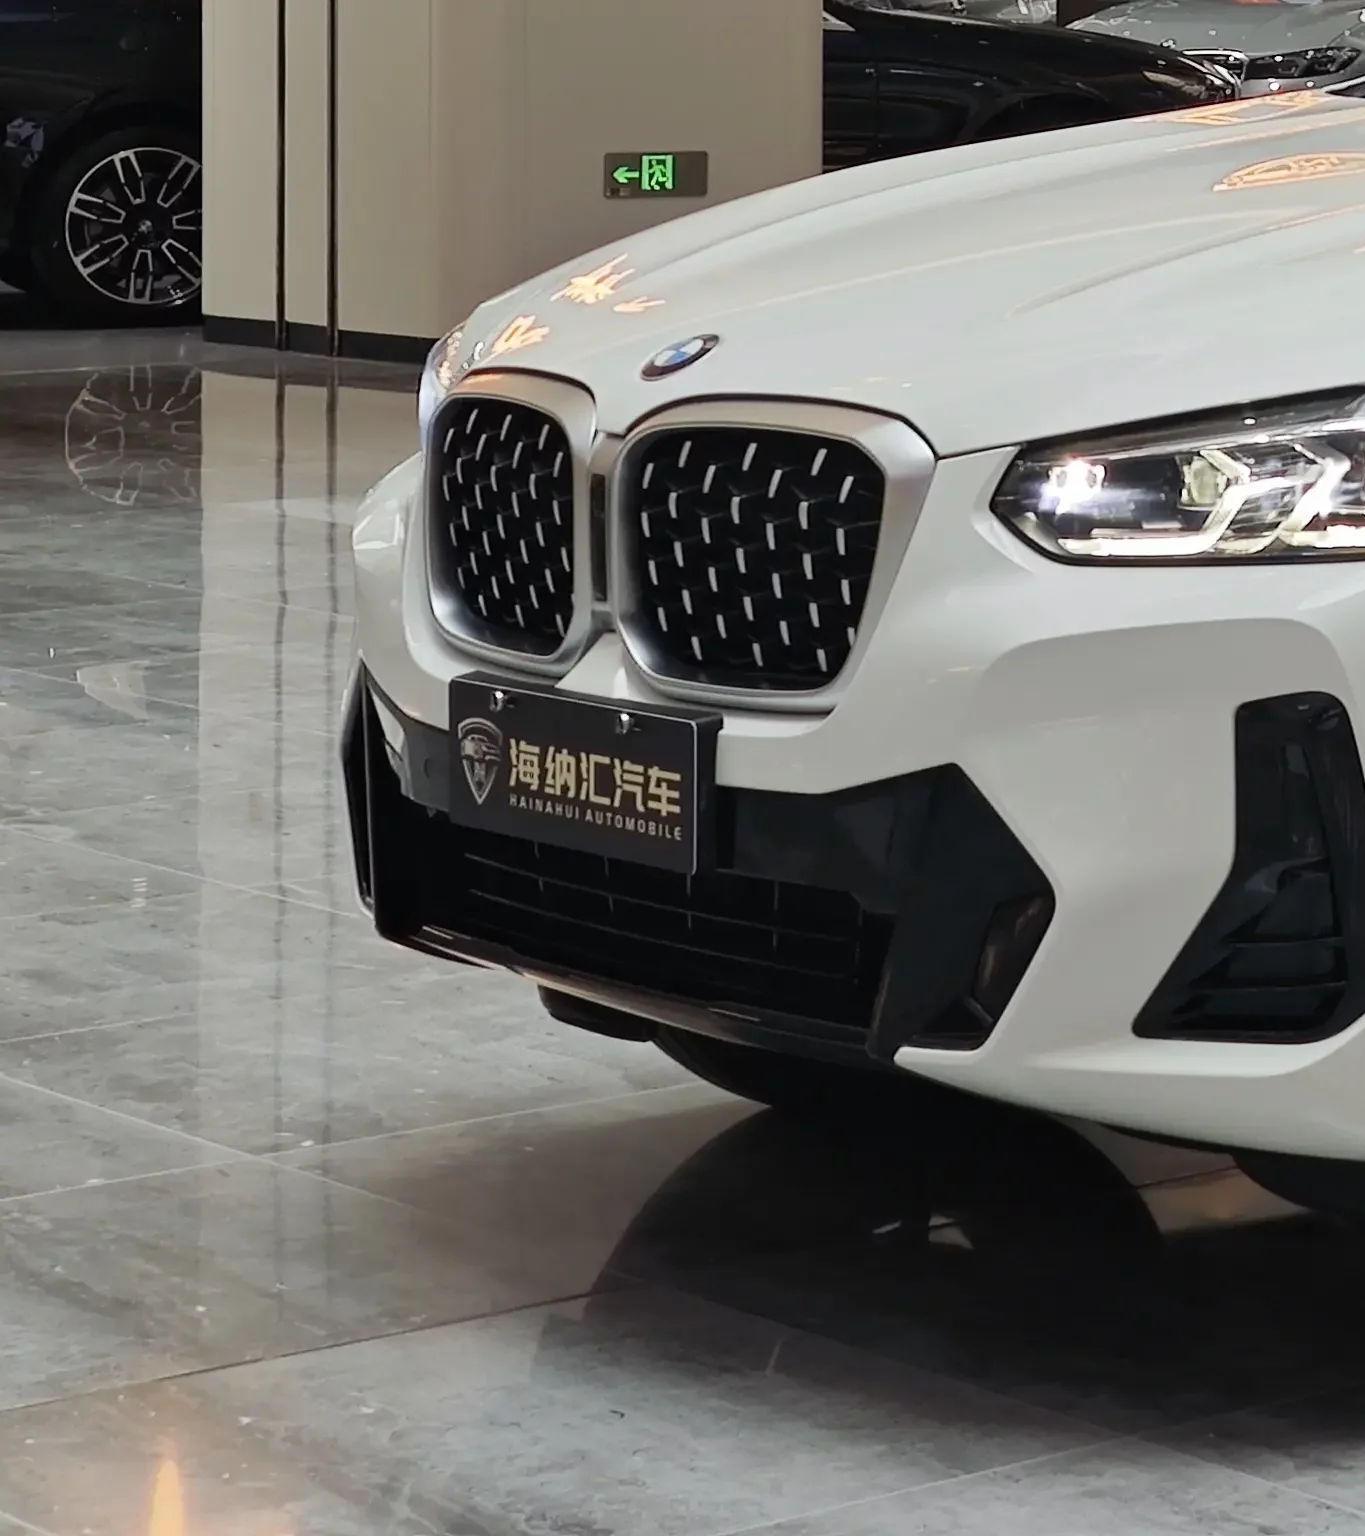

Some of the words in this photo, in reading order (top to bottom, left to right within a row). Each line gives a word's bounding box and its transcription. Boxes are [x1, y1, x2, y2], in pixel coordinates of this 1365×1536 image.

[508, 738, 682, 817] 海纳汇汽车
[509, 793, 580, 821] HAINAHUI
[585, 808, 683, 841] AUTOMOBILE
